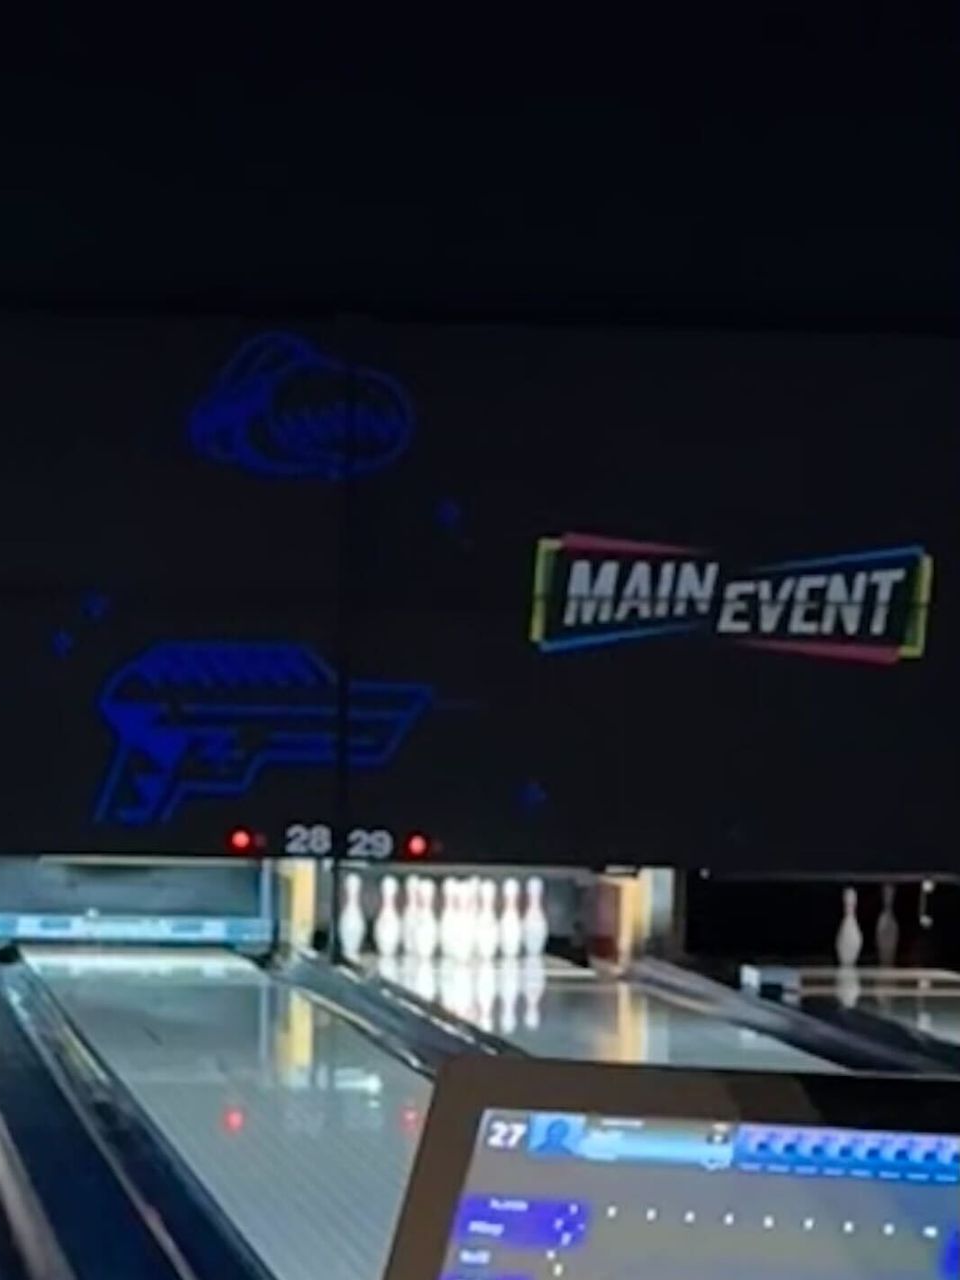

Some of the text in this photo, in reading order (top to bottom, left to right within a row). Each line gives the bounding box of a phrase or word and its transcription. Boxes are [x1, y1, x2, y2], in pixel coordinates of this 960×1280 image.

[563, 560, 906, 635] MAIN EVENT
[285, 823, 332, 854] 28
[347, 828, 394, 858] 29
[488, 1120, 527, 1148] 27
